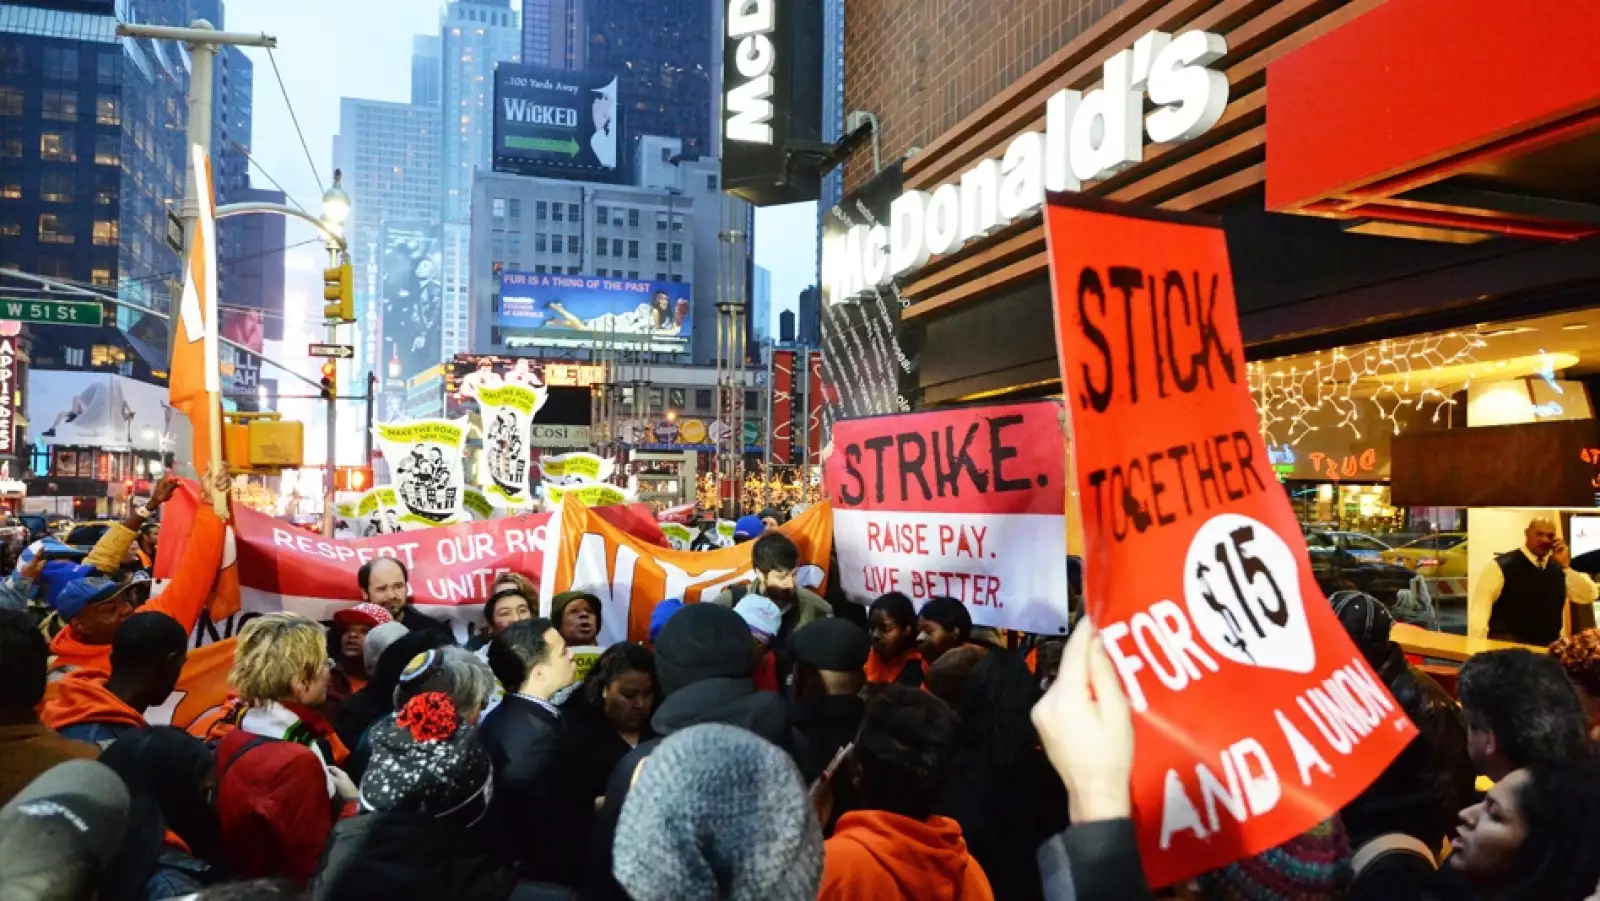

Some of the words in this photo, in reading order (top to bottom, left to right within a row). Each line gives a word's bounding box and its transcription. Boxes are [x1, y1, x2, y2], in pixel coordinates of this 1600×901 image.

[530, 78, 553, 90] Yards
[555, 81, 579, 96] Away
[822, 29, 1229, 305] McDonald's
[7, 303, 23, 316] W
[29, 304, 51, 319] 51
[57, 306, 77, 320] St
[503, 274, 526, 285] FUR
[528, 276, 540, 286] IS
[539, 277, 549, 287] A
[552, 277, 584, 289] THING
[586, 279, 600, 290] OF
[603, 280, 623, 292] THE
[625, 281, 651, 293] PAST
[1077, 265, 1237, 414] STICK
[838, 414, 1049, 506] STRIKE.
[1089, 431, 1265, 542] TOGETHER
[436, 534, 497, 567] OUR
[867, 521, 929, 555] RAISE
[938, 524, 997, 559] PAY.
[863, 565, 900, 594] LIVE
[911, 571, 1004, 609] BETTER.
[1196, 526, 1289, 662] $15
[1101, 599, 1220, 713] FOR
[1273, 708, 1334, 786] A
[1296, 658, 1395, 755] UNION
[1159, 737, 1282, 850] AND
